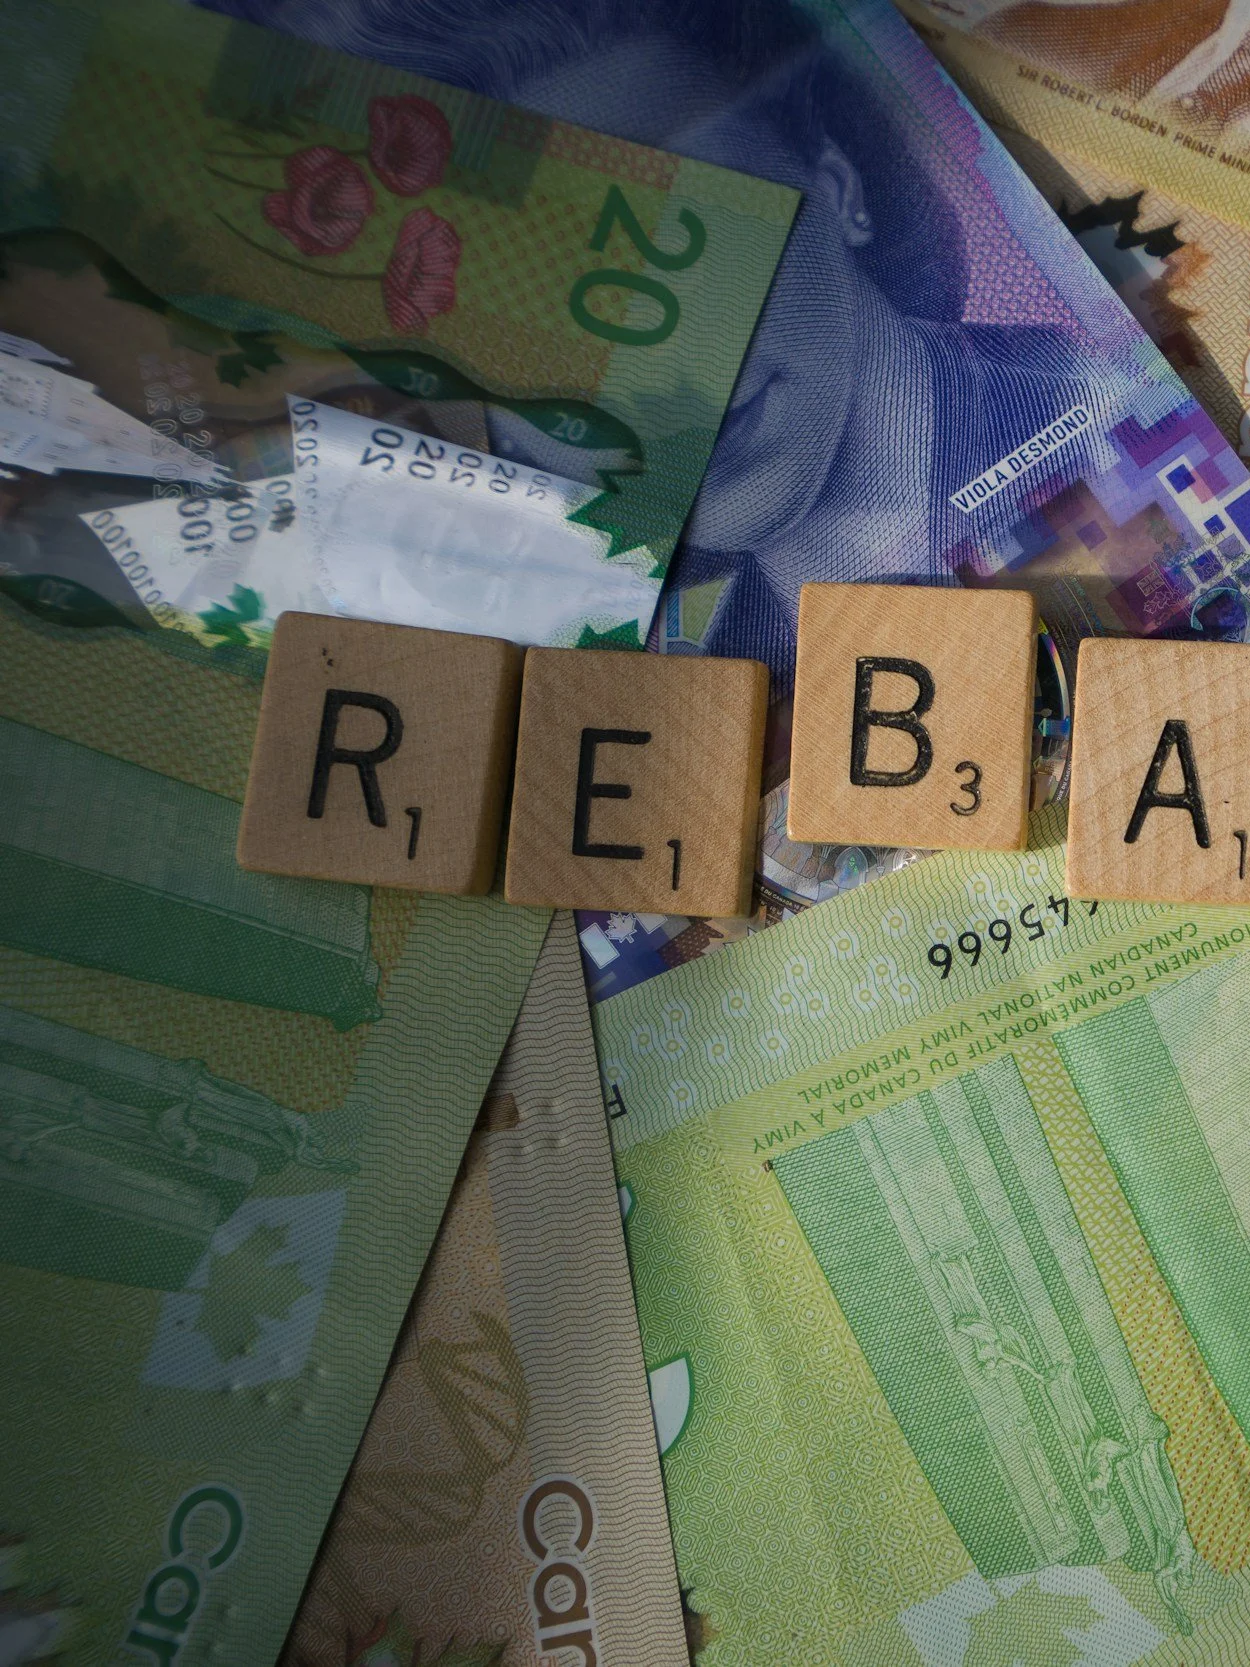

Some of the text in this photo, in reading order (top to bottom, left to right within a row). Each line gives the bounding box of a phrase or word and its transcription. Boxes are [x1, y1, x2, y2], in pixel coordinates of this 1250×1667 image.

[1017, 64, 1039, 82] SIR
[1040, 74, 1094, 105] ROBERT
[1111, 103, 1168, 138] BORDEN
[1173, 131, 1216, 160] PRIME
[569, 184, 706, 346] 20
[549, 414, 588, 441] 20
[408, 440, 445, 480] 20
[488, 464, 517, 493] 20
[955, 408, 1088, 509] VIOLA DESMOND
[950, 761, 982, 816] 3
[405, 807, 422, 860] 1
[1234, 829, 1247, 880] 1
[666, 839, 683, 891] 1
[798, 922, 1198, 1104] CANADIAN NATIONAL VIMY MEMORIAL
[966, 974, 1135, 1060] COMMÉMORATIF
[929, 1051, 960, 1075] DU
[832, 1068, 921, 1115] CANADA
[753, 1120, 807, 1154] VIMY
